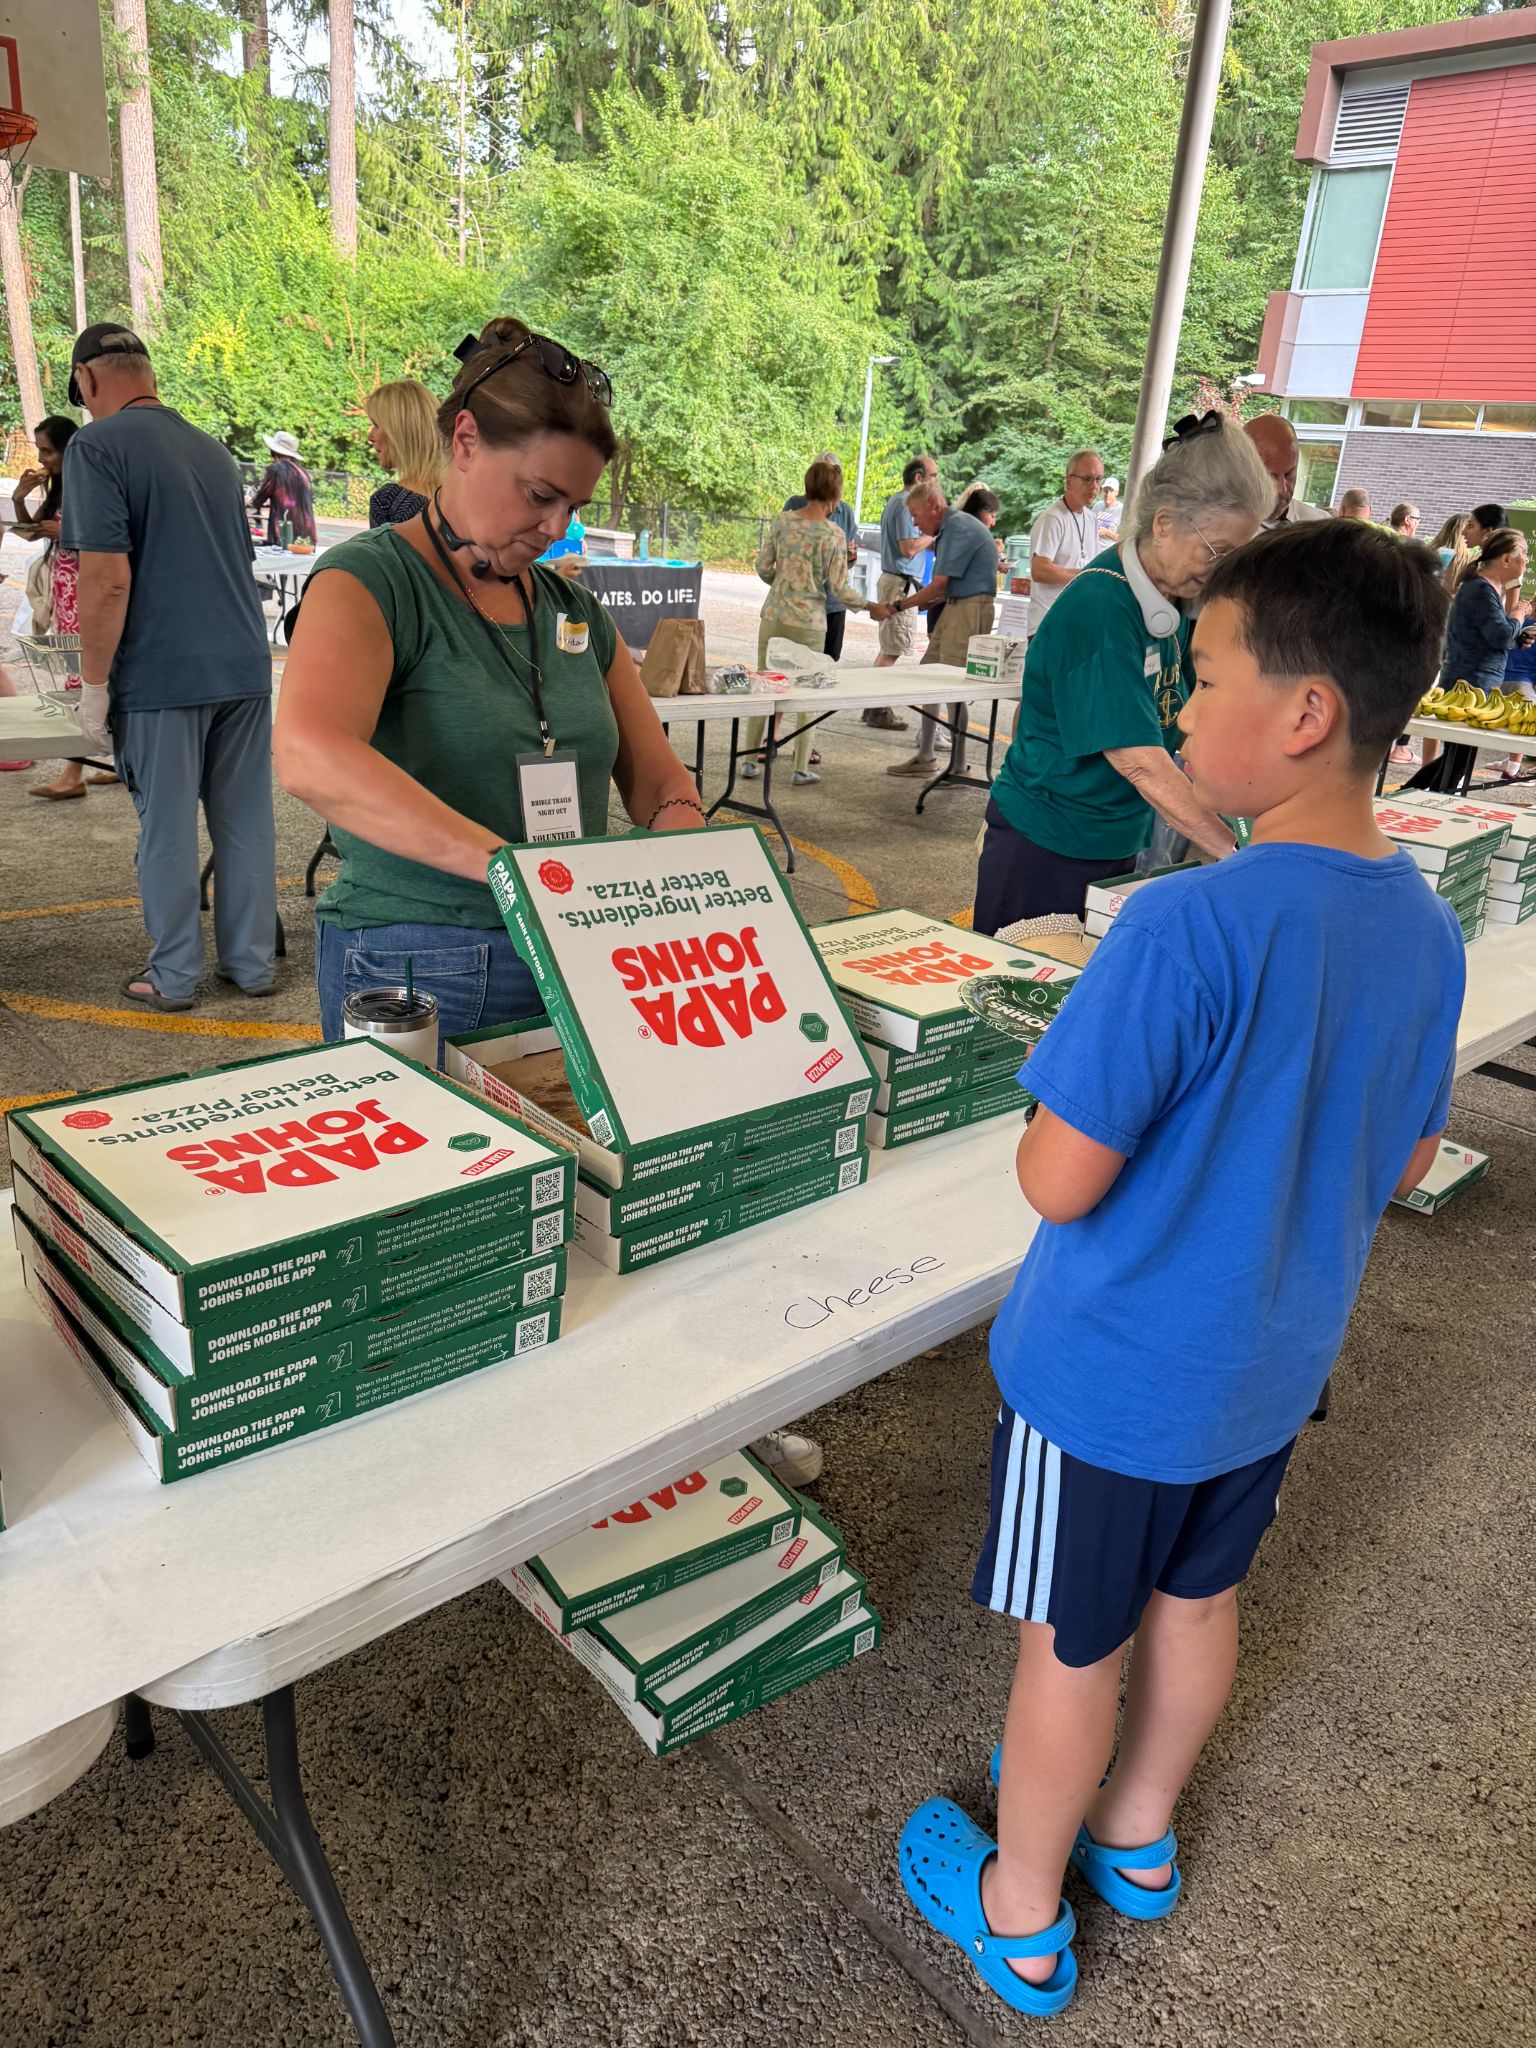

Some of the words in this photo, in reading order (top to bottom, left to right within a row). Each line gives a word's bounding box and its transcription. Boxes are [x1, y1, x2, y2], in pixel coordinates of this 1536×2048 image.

[641, 590, 663, 605] DO
[667, 588, 697, 604] LIFE.
[538, 808, 555, 817] NIGHT
[556, 807, 567, 815] OUT
[1238, 820, 1248, 837] FOOD
[531, 830, 576, 842] VOLUNTEER
[488, 868, 511, 913] REWARDS
[494, 860, 517, 907] PAPA
[586, 879, 657, 901] Pizza.
[661, 870, 731, 892] Better
[705, 885, 773, 908] Better
[558, 891, 702, 929] Ingredients.
[515, 912, 529, 935] EARN
[524, 936, 537, 957] FREE
[533, 956, 545, 980] FOOD
[853, 926, 906, 942] Better
[891, 925, 944, 942] Better
[611, 926, 764, 991] JOHNS
[841, 941, 959, 974] JOHNS
[872, 953, 994, 986] PAPA
[630, 971, 787, 1048] PAPA
[807, 1062, 826, 1079] PIZZA
[821, 1050, 841, 1068] TEAM
[242, 1073, 340, 1102] Better
[301, 1070, 400, 1100] Better
[87, 1098, 298, 1146] Ingredients.
[132, 1097, 241, 1123] Pizza.
[165, 1098, 392, 1171] JOHNS
[193, 1121, 430, 1195] PAPA
[632, 1166, 659, 1181] JOHNS
[660, 1156, 688, 1171] MOBILE
[689, 1152, 705, 1163] APP
[633, 1151, 677, 1171] DOWNLOAD
[678, 1146, 693, 1157] THE
[693, 1140, 713, 1152] PAPA
[620, 1192, 665, 1213] DOWNLOAD
[666, 1187, 680, 1198] THE
[681, 1180, 701, 1193] PAPA
[620, 1207, 648, 1223] JOHNS
[649, 1197, 677, 1213] MOBILE
[678, 1192, 694, 1204] APP
[630, 1231, 674, 1252] DOWNLOAD
[674, 1225, 689, 1236] THE
[689, 1218, 708, 1231] PAPA
[630, 1246, 657, 1262] JOHNS
[658, 1235, 685, 1252] MOBILE
[686, 1230, 701, 1241] APP
[198, 1267, 269, 1297] DOWNLOAD
[271, 1259, 293, 1274] THE
[295, 1249, 326, 1266] PAPA
[199, 1288, 243, 1311] JOHNS
[245, 1273, 290, 1296] MOBILE
[291, 1265, 315, 1281] APP
[784, 1256, 946, 1329] Cheese
[208, 1318, 277, 1350] DOWNLOAD
[278, 1309, 301, 1325] THE
[302, 1299, 332, 1317] PAPA
[208, 1340, 251, 1363] JOHNS
[253, 1324, 296, 1347] MOBILE
[298, 1315, 321, 1331] APP
[355, 1380, 374, 1391] When
[375, 1375, 389, 1384] that
[390, 1369, 406, 1380] pizza
[406, 1360, 430, 1372] craving
[431, 1356, 444, 1364] hits,
[445, 1351, 456, 1359] tap
[467, 1343, 479, 1351] app
[479, 1337, 492, 1348] and
[492, 1333, 508, 1347] order
[355, 1390, 371, 1401] your
[371, 1383, 390, 1394] go-to
[390, 1372, 419, 1386] wherever
[420, 1368, 432, 1377] you
[432, 1364, 442, 1373] go.
[442, 1358, 456, 1368] And
[456, 1352, 476, 1363] guess
[475, 1344, 492, 1356] what?
[190, 1375, 261, 1407] DOWNLOAD
[262, 1366, 285, 1381] THE
[287, 1355, 317, 1373] PAPA
[191, 1397, 235, 1420] JOHNS
[236, 1380, 281, 1404] MOBILE
[283, 1371, 306, 1387] APP
[355, 1399, 370, 1407] also
[370, 1394, 381, 1402] the
[382, 1388, 396, 1398] best
[397, 1382, 415, 1394] place
[423, 1373, 436, 1383] find
[436, 1370, 447, 1378] our
[447, 1364, 461, 1374] best
[462, 1358, 479, 1368] deals.
[177, 1425, 248, 1456] DOWNLOAD
[250, 1416, 273, 1431] THE
[274, 1405, 305, 1423] PAPA
[178, 1446, 222, 1469] JOHNS
[224, 1429, 268, 1453] MOBILE
[270, 1420, 294, 1436] APP
[730, 1507, 746, 1524] PIZZA
[745, 1498, 761, 1513] TEAM
[781, 1553, 796, 1569] PIZZA
[791, 1538, 808, 1555] TEAM
